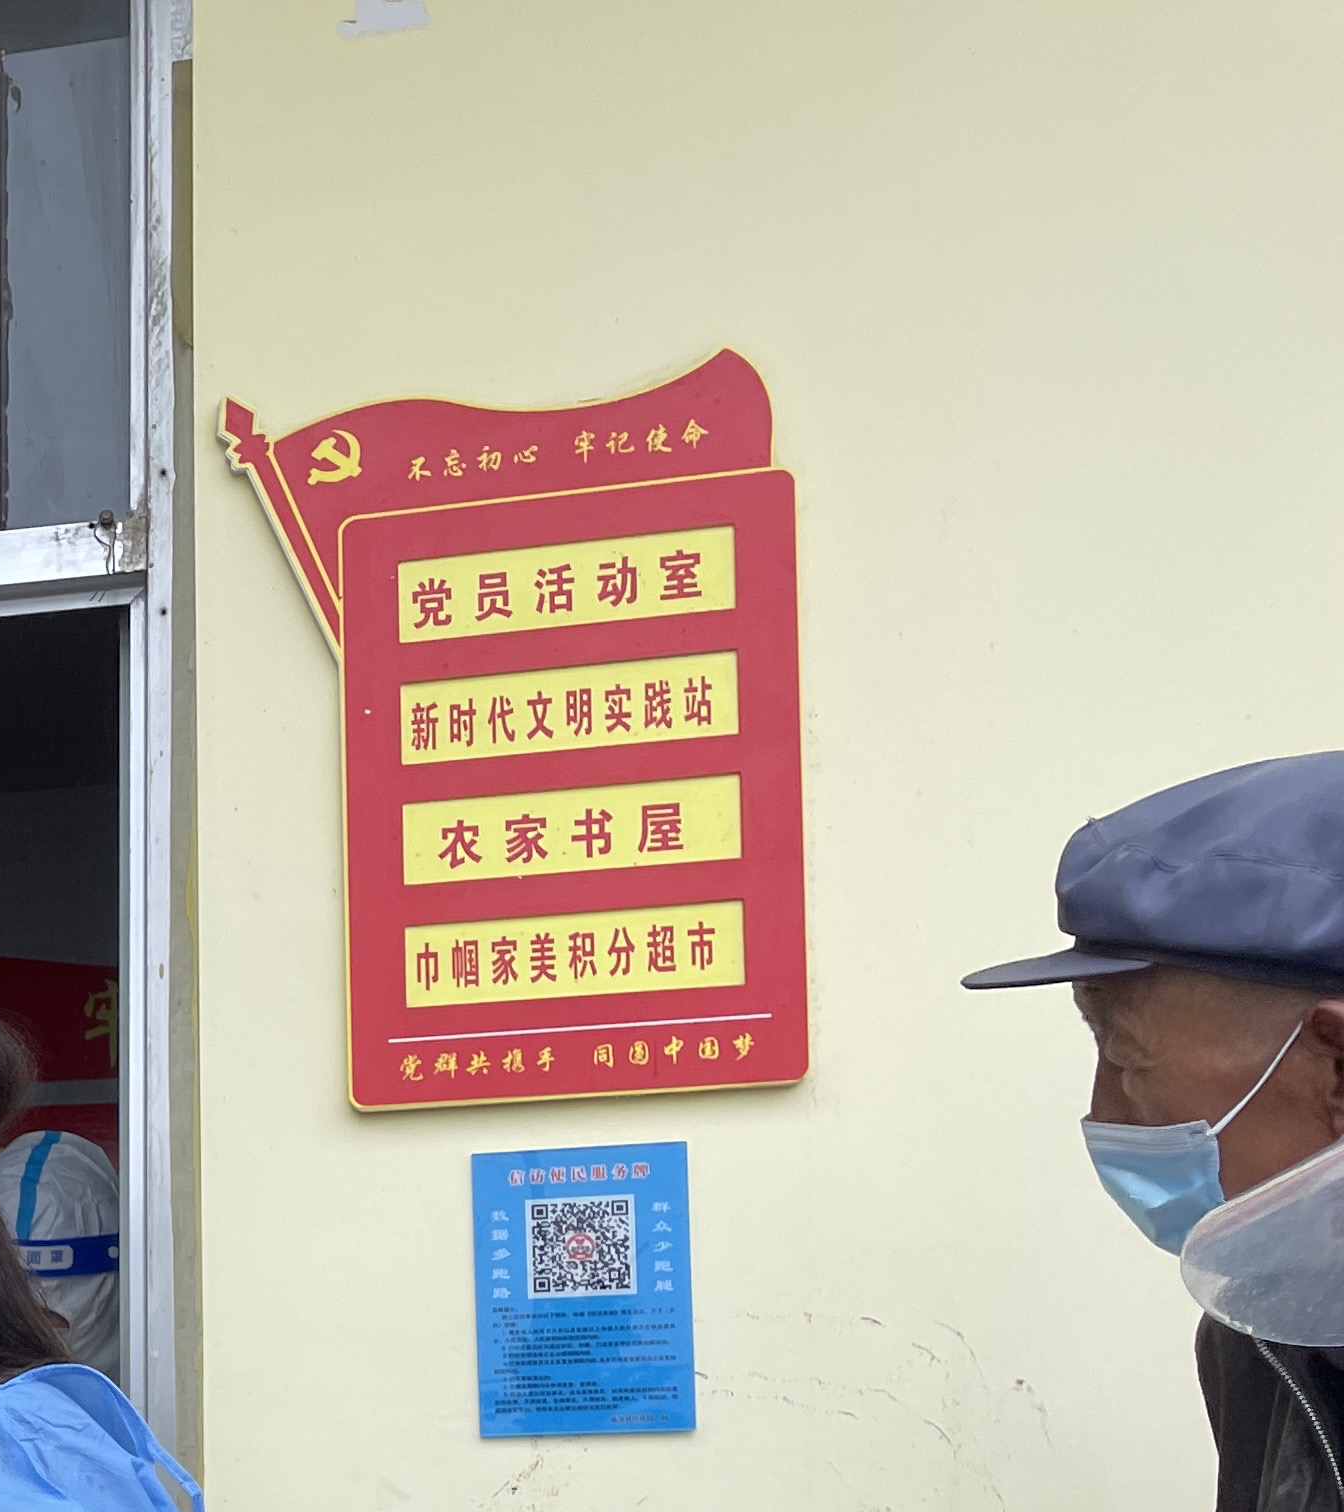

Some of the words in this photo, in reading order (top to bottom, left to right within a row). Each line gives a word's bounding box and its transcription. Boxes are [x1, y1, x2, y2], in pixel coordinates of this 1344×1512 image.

[407, 445, 539, 482] 不忘初心
[574, 418, 709, 464] 牢记使命
[411, 549, 704, 630] 党员活动室
[410, 675, 714, 752] 新时代文明实践站
[437, 801, 686, 870] 农家书屋
[415, 921, 716, 989] 巾帼家美积分超市
[399, 1046, 556, 1082] 党群共携手
[593, 1031, 755, 1068] 同圆中国梦
